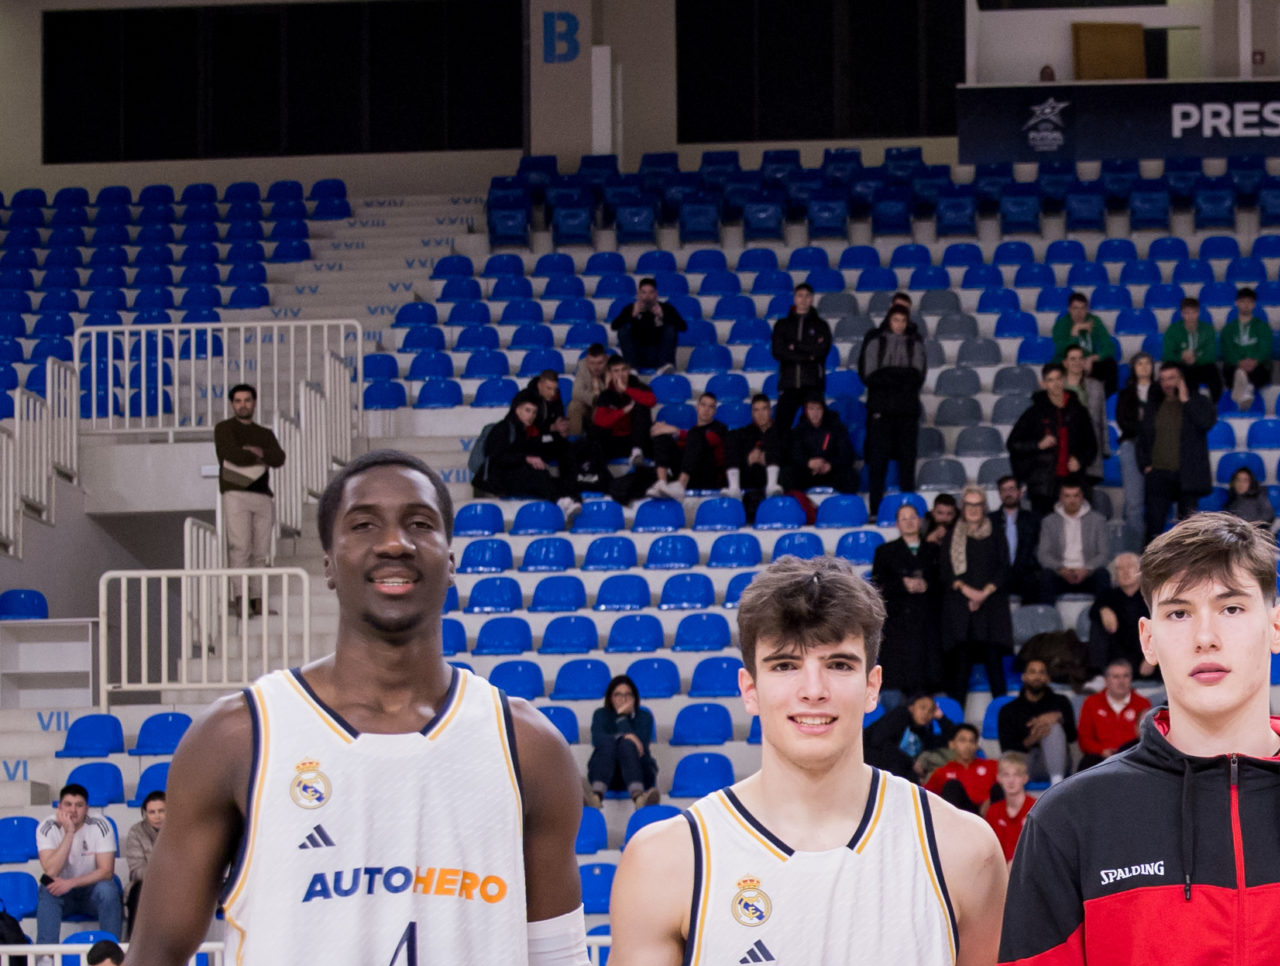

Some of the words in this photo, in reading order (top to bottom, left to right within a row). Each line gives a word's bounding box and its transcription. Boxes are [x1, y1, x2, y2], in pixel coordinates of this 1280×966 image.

[544, 12, 580, 64] B
[37, 711, 69, 731] VII
[2, 759, 28, 781] VI
[302, 866, 508, 903] AUTOHERO
[1100, 861, 1164, 885] SPALDING
